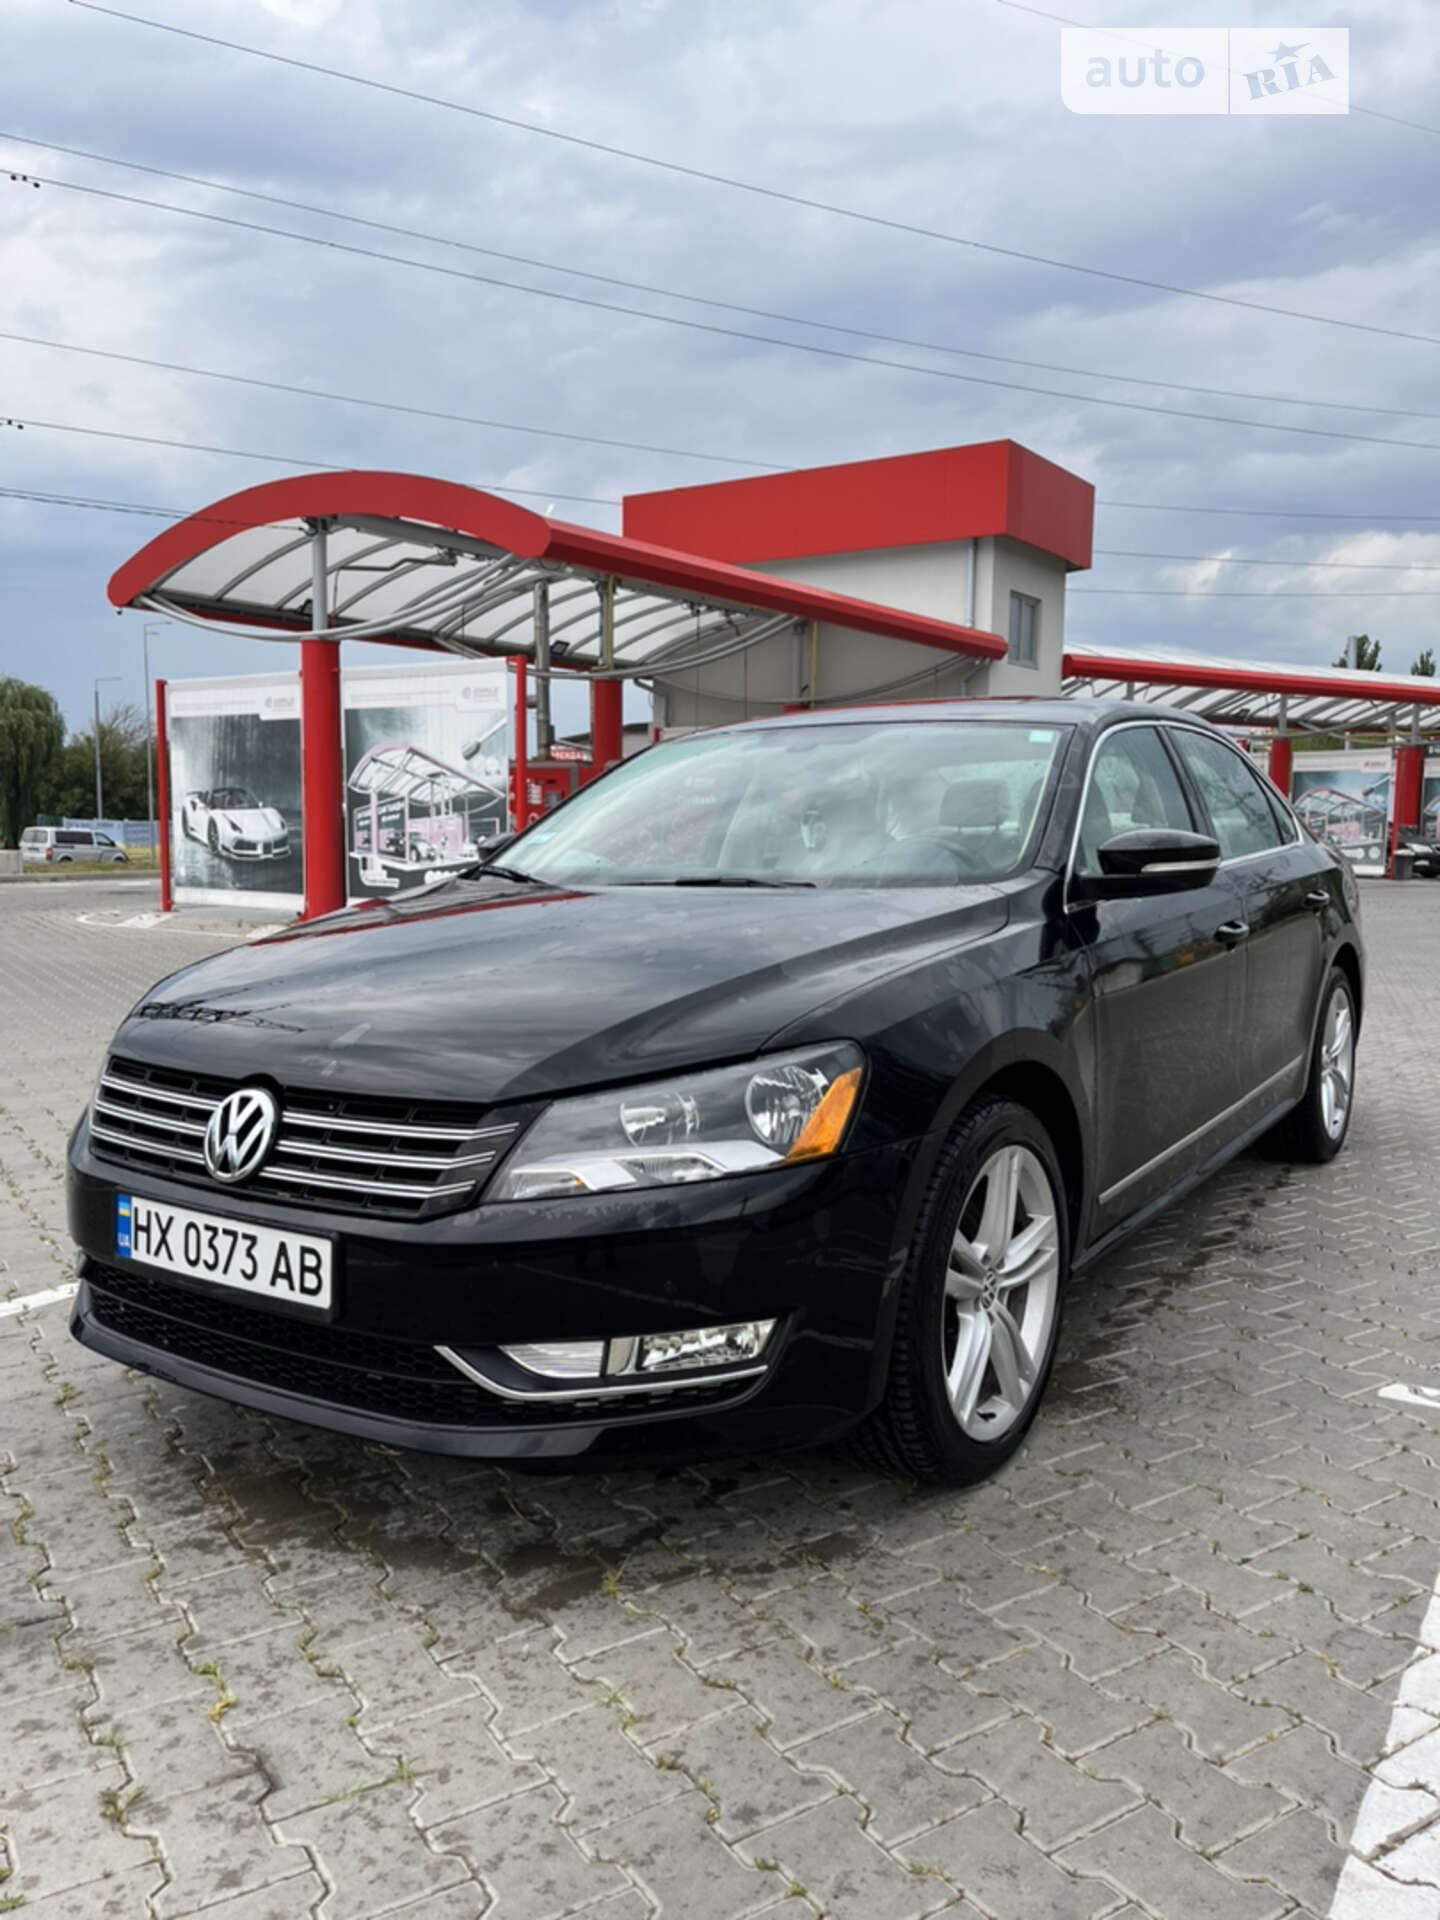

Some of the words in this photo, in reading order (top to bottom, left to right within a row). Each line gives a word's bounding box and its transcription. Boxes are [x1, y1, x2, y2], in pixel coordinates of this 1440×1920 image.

[133, 1206, 175, 1262] HX
[184, 1220, 259, 1282] 0373
[269, 1240, 324, 1297] AB
